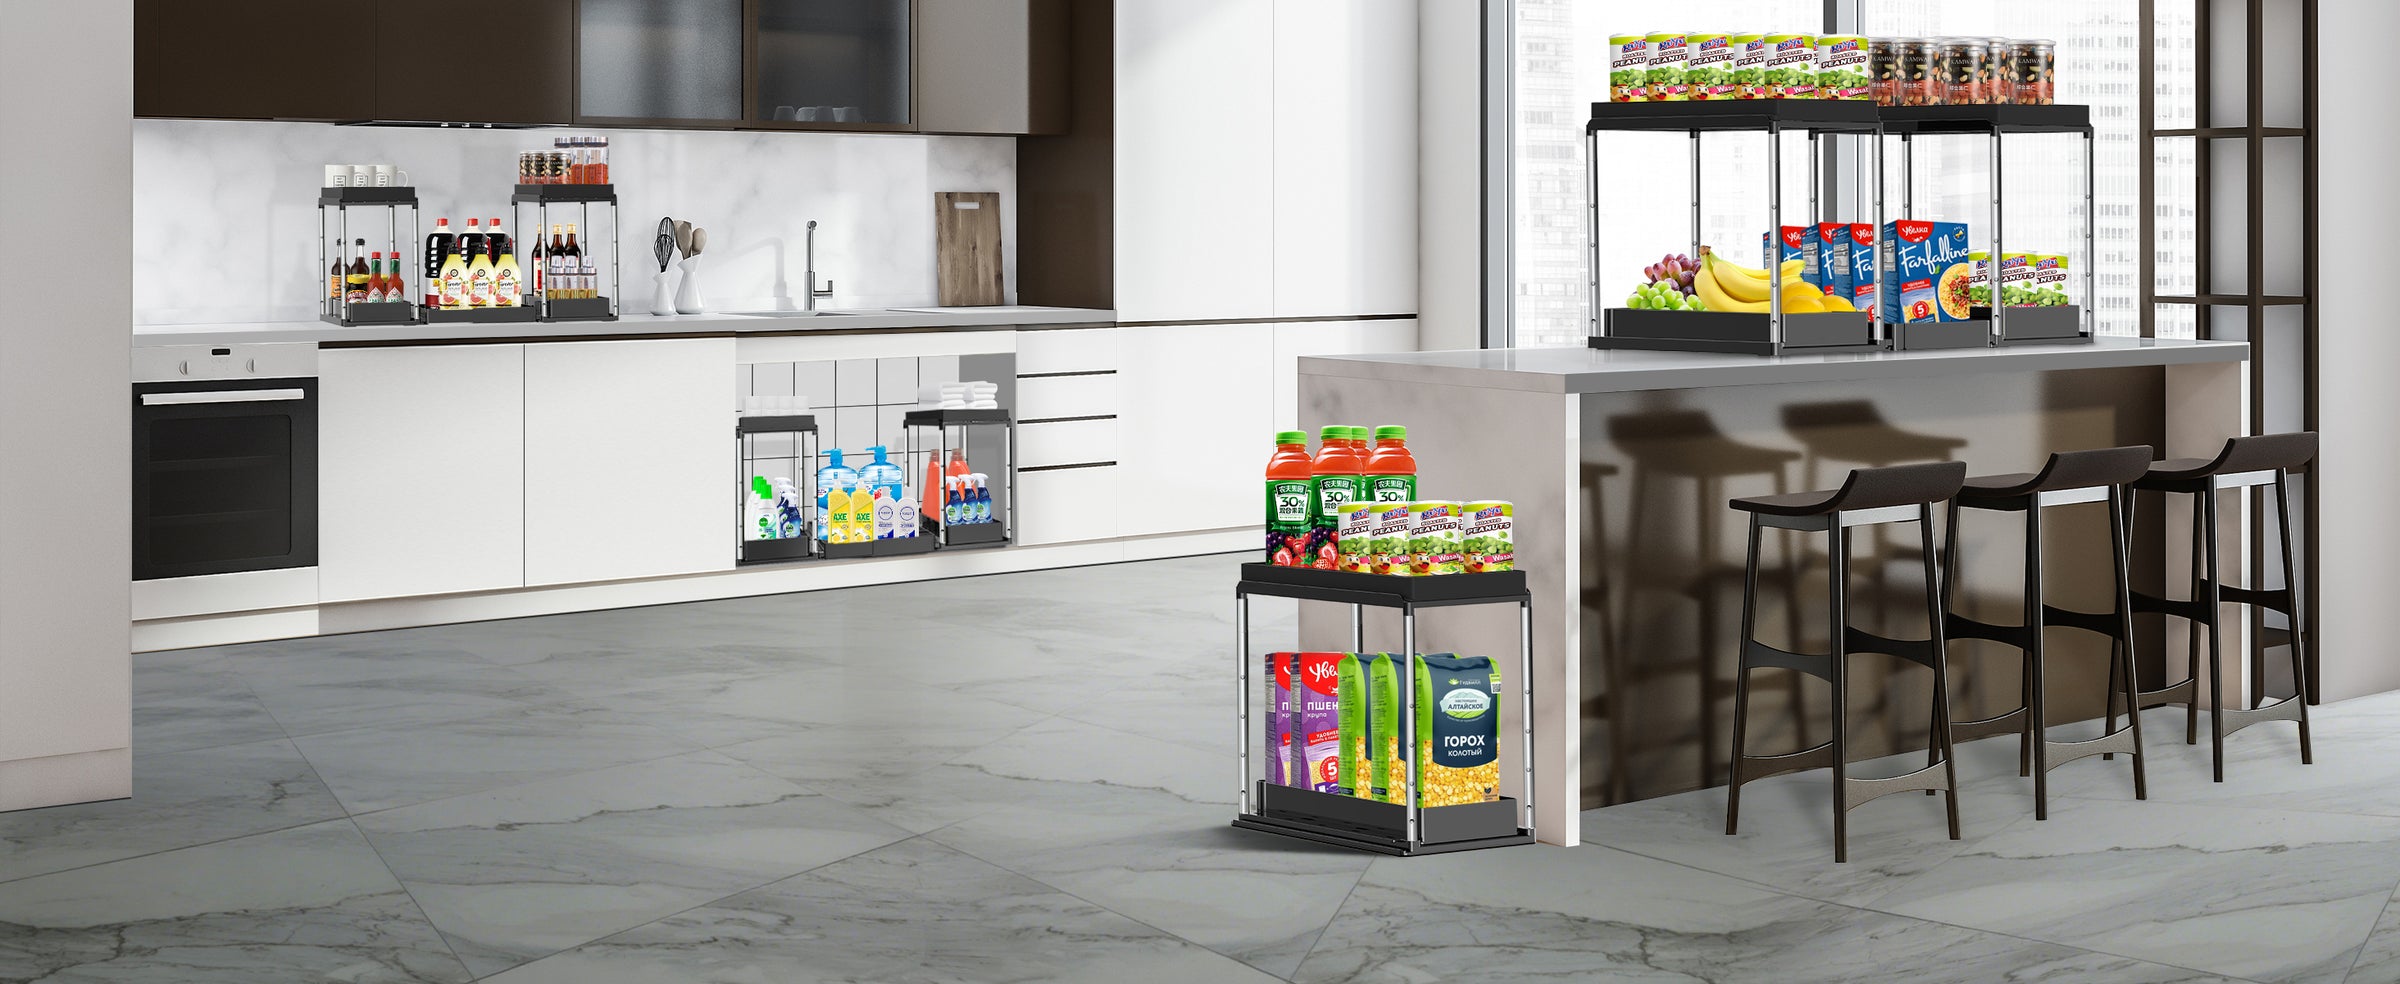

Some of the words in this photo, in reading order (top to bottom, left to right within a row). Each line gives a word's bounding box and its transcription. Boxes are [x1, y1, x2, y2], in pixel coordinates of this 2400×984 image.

[1613, 57, 1646, 68] PEANU
[1649, 54, 1688, 66] PEANUT
[1737, 56, 1764, 66] PEAN
[1767, 54, 1813, 67] PEANUTS
[1821, 56, 1867, 69] PEANUTS
[1716, 85, 1735, 95] Wasa
[1898, 234, 1969, 277] Farfalline
[2002, 272, 2035, 283] ANUTS
[2037, 274, 2066, 284] NUTS
[1917, 305, 1925, 314] 5
[1280, 497, 1304, 507] 30%
[1325, 492, 1350, 502] 30%
[1379, 492, 1404, 502] 30%
[1342, 526, 1369, 536] PEAN
[1373, 525, 1409, 536] PEANUT
[1412, 522, 1457, 535] PEANUTS
[1466, 522, 1511, 535] PEANUTS
[1309, 661, 1338, 682] Уве
[1444, 735, 1485, 747] ГОРОХ
[1328, 762, 1338, 776] 5
